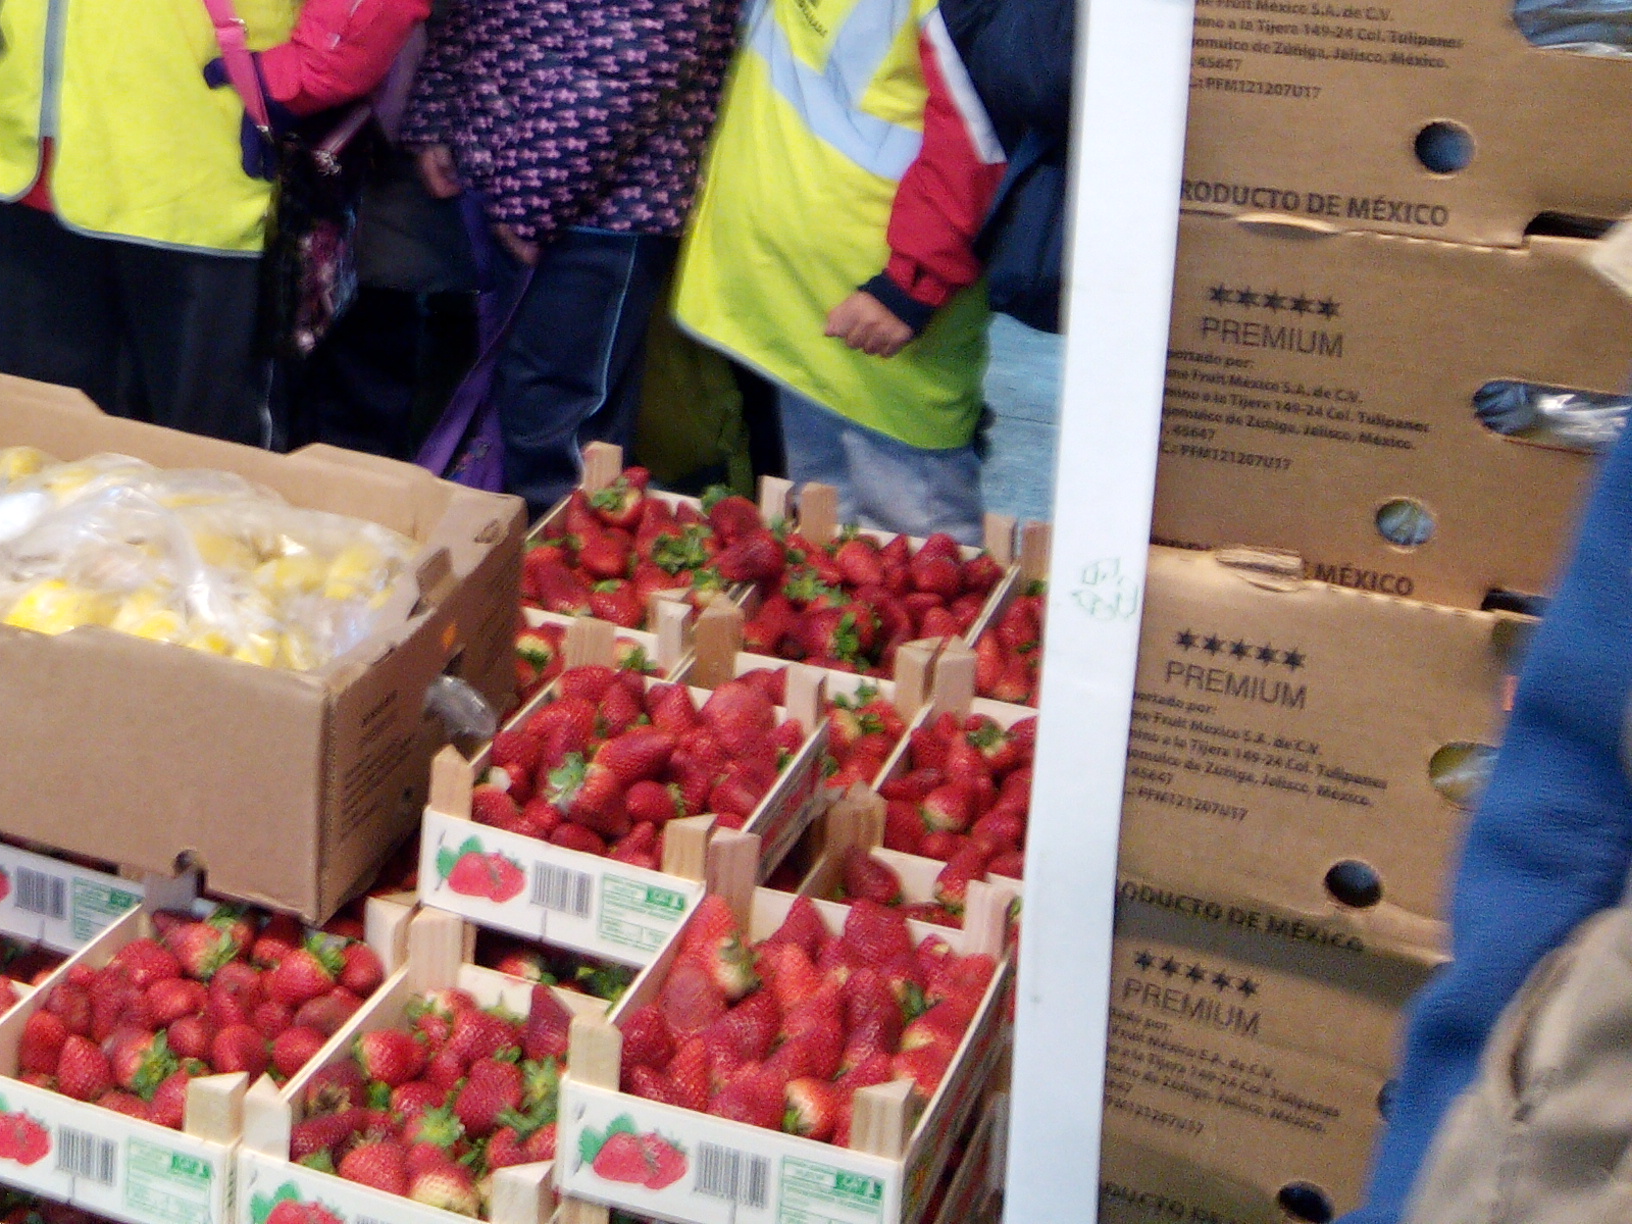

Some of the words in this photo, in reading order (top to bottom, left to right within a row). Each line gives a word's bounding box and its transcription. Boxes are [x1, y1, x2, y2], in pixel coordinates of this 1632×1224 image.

[1342, 5, 1362, 19] de
[1365, 6, 1394, 21] C.V.
[1241, 19, 1253, 31] la
[1257, 19, 1299, 36] Tijera
[1356, 28, 1386, 42] Col.
[1386, 29, 1464, 48] Tulipanes
[1252, 41, 1272, 53] de
[1181, 179, 1301, 212] RODUCTO
[1307, 192, 1342, 217] DE
[1347, 194, 1450, 227] MÉXICO
[1201, 316, 1343, 358] PREMIUM
[1313, 385, 1332, 399] de
[1230, 393, 1271, 410] Tijera
[1357, 411, 1431, 434] Tulipanes
[1314, 562, 1414, 596] MÉXICO
[1165, 659, 1307, 710] PREMIUM
[1153, 711, 1187, 728] Fruit
[1273, 735, 1291, 750] de
[1173, 734, 1187, 749] la
[1190, 738, 1230, 757] Tijera
[1120, 880, 1223, 920] ODUCTO
[1228, 905, 1261, 928] DE
[1122, 978, 1260, 1038] PREMIUM
